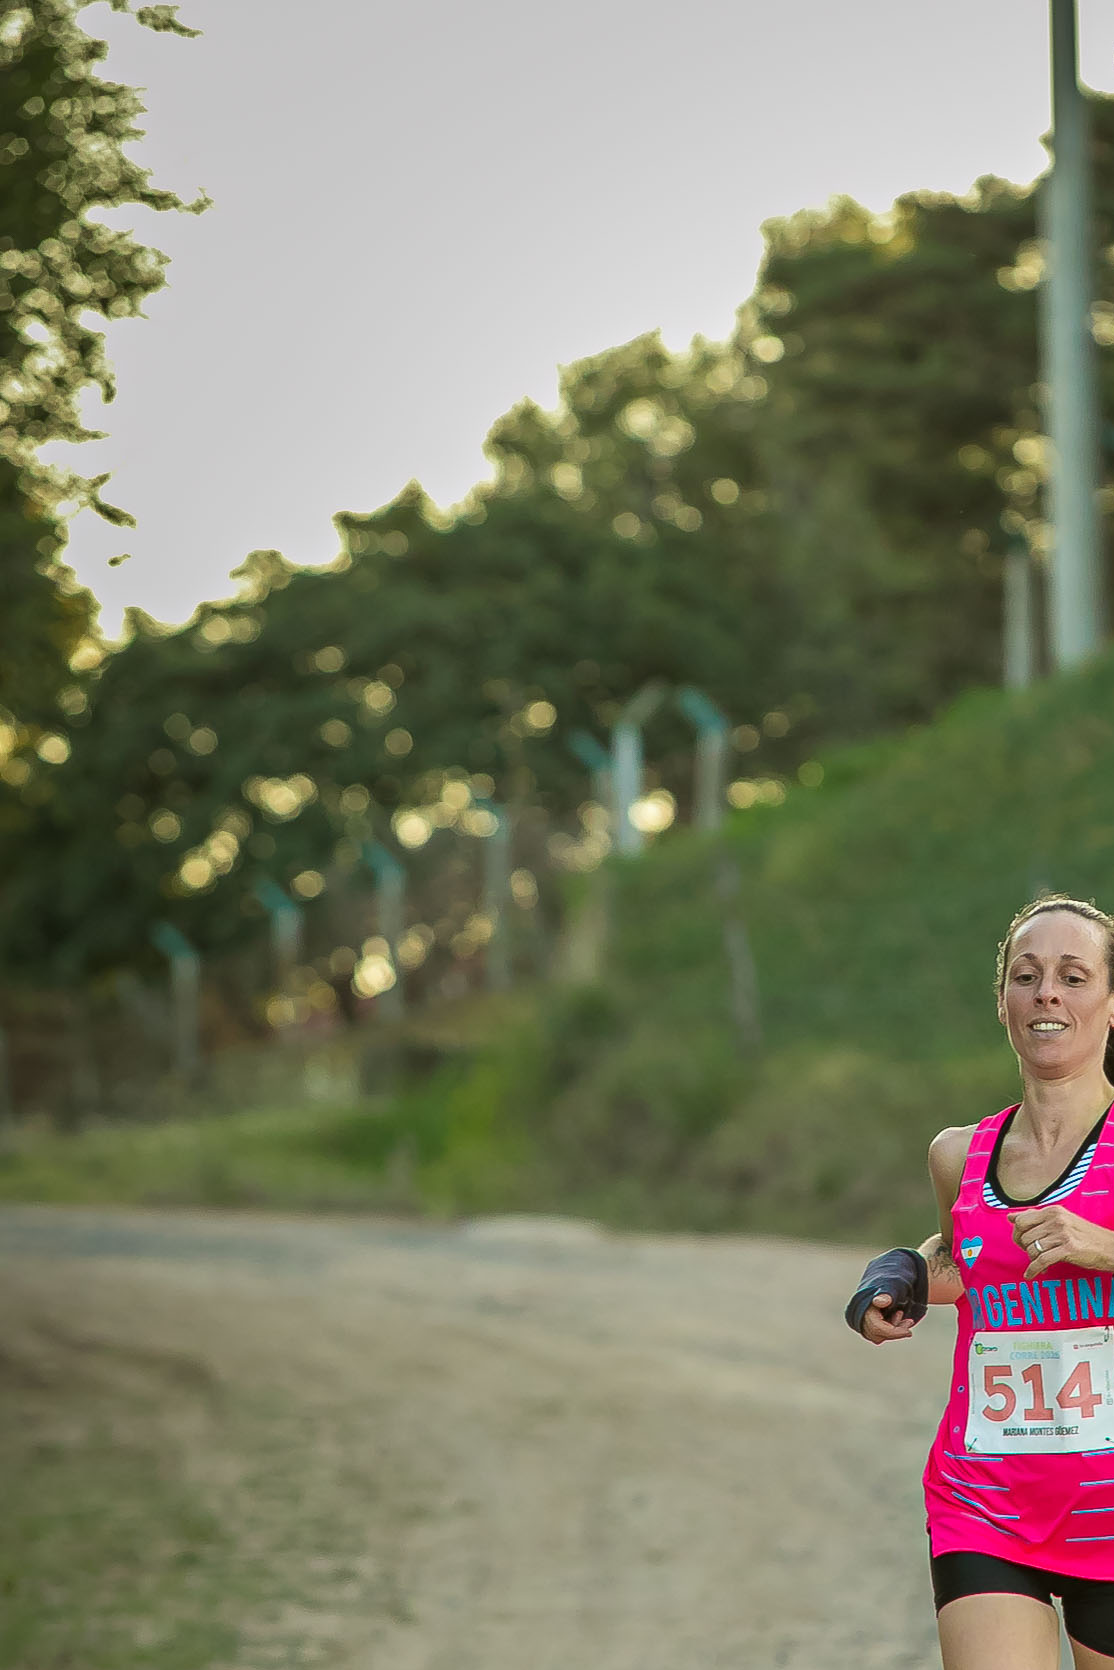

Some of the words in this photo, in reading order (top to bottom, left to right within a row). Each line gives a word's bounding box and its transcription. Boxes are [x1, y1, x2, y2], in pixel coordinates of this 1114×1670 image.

[982, 1361, 1103, 1422] 514
[1002, 1427, 1028, 1437] MARIANA
[1029, 1426, 1054, 1436] MONTES
